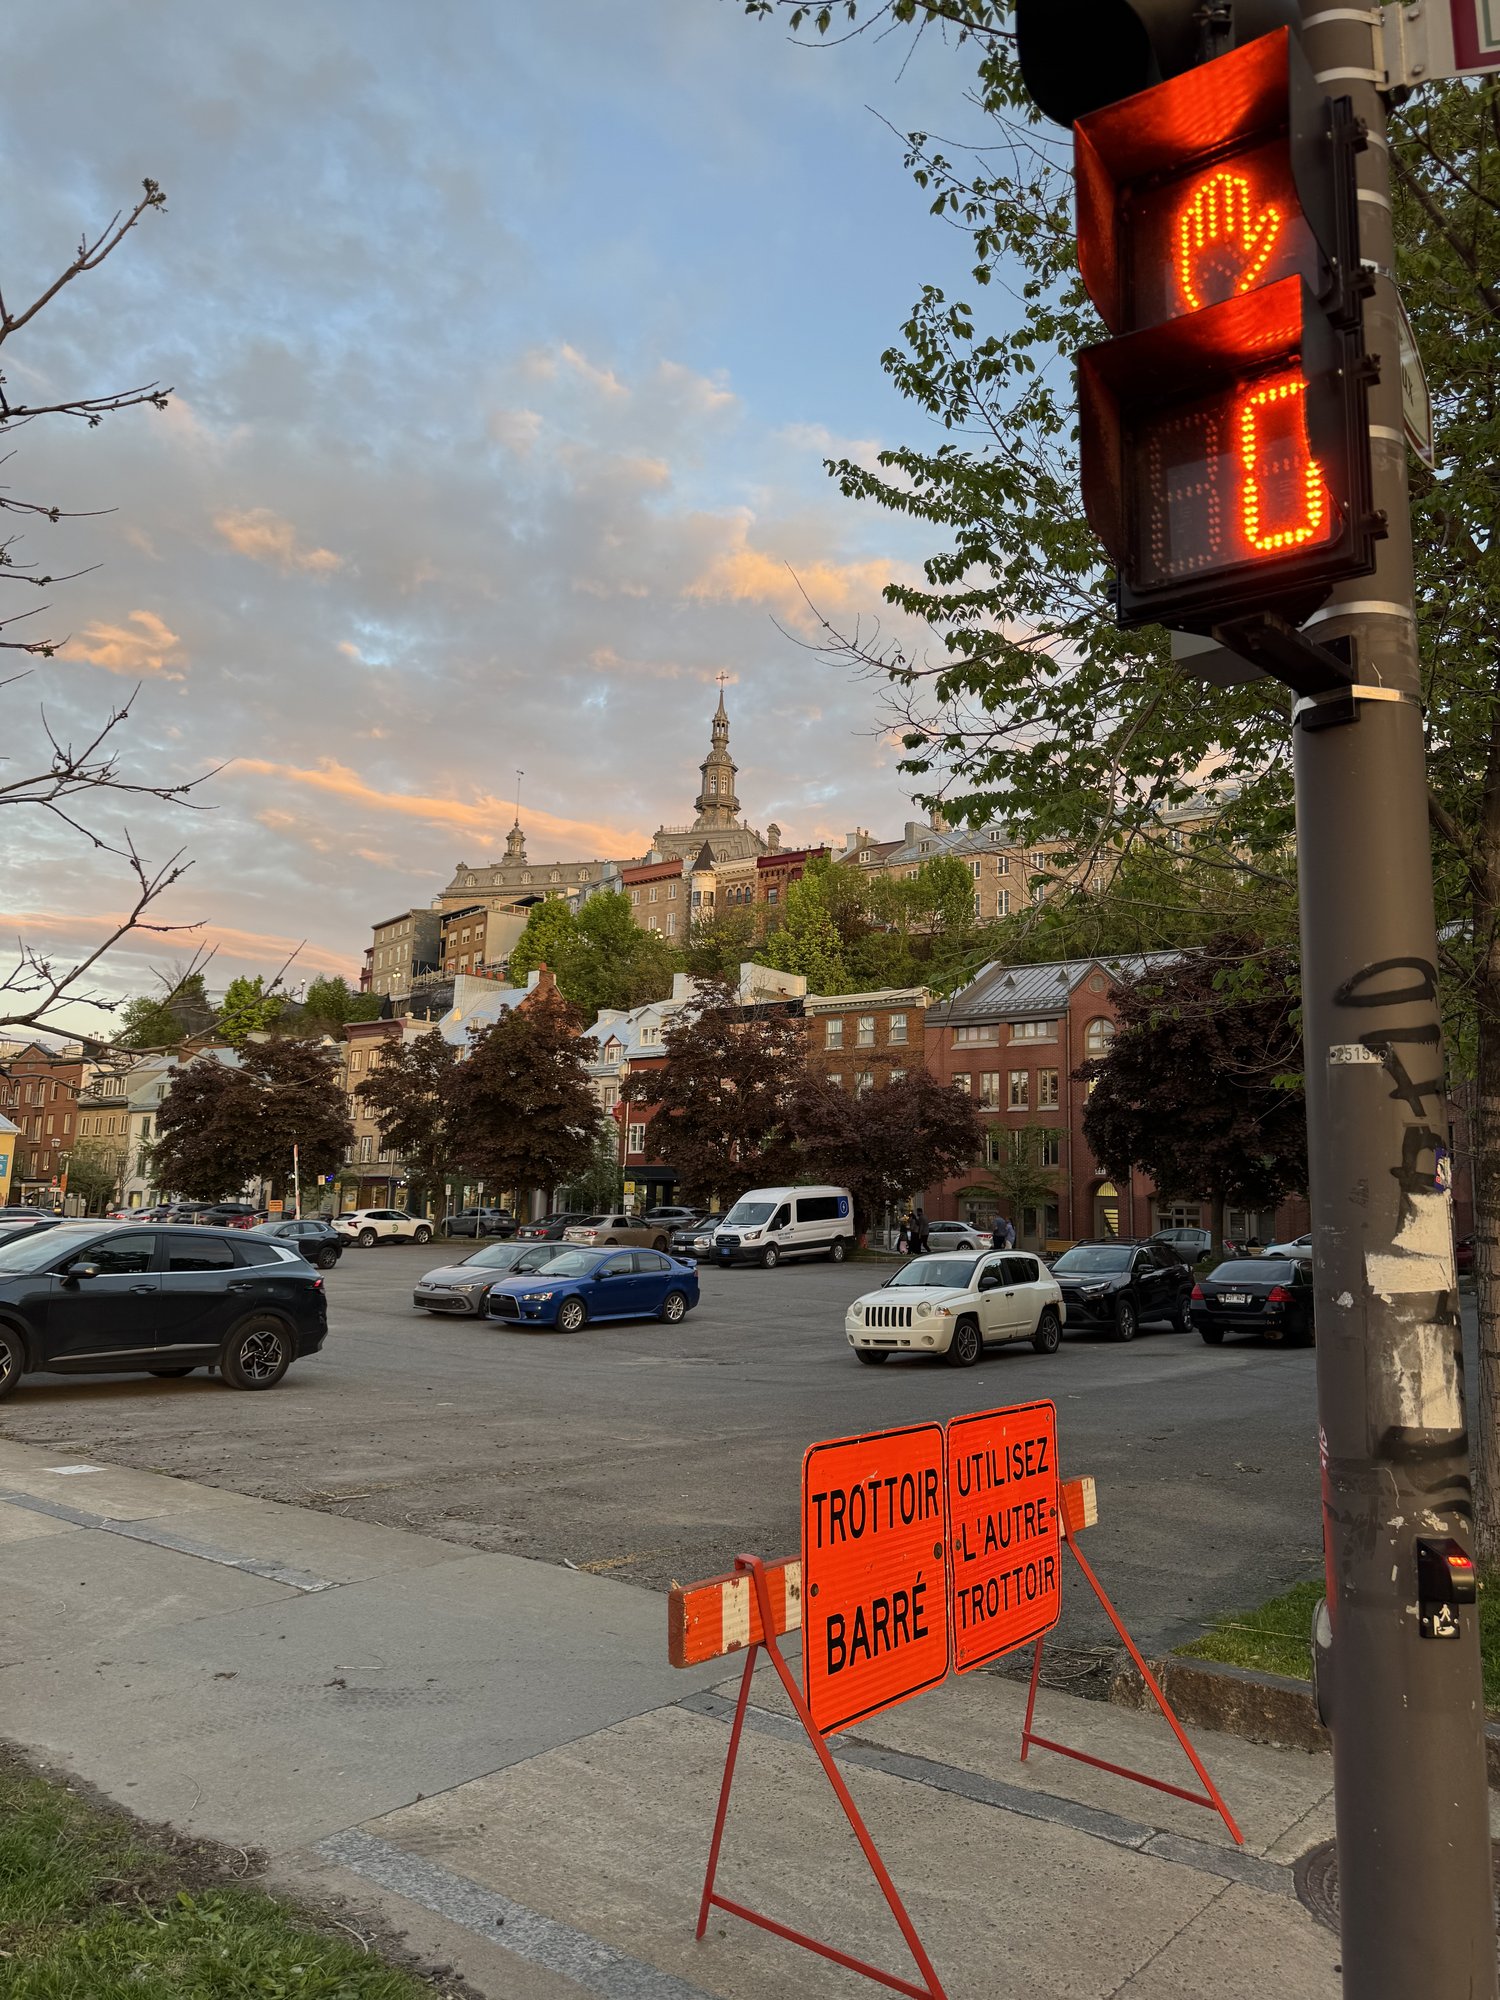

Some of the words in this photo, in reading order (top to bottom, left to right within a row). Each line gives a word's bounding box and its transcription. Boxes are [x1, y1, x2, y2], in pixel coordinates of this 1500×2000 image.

[956, 1436, 1049, 1497] UTILISEZ
[811, 1467, 939, 1549] TROTTOIR
[961, 1497, 1049, 1563] L'AUTRE
[826, 1571, 929, 1676] BARRÉ
[957, 1555, 1056, 1630] TROTTOIR
